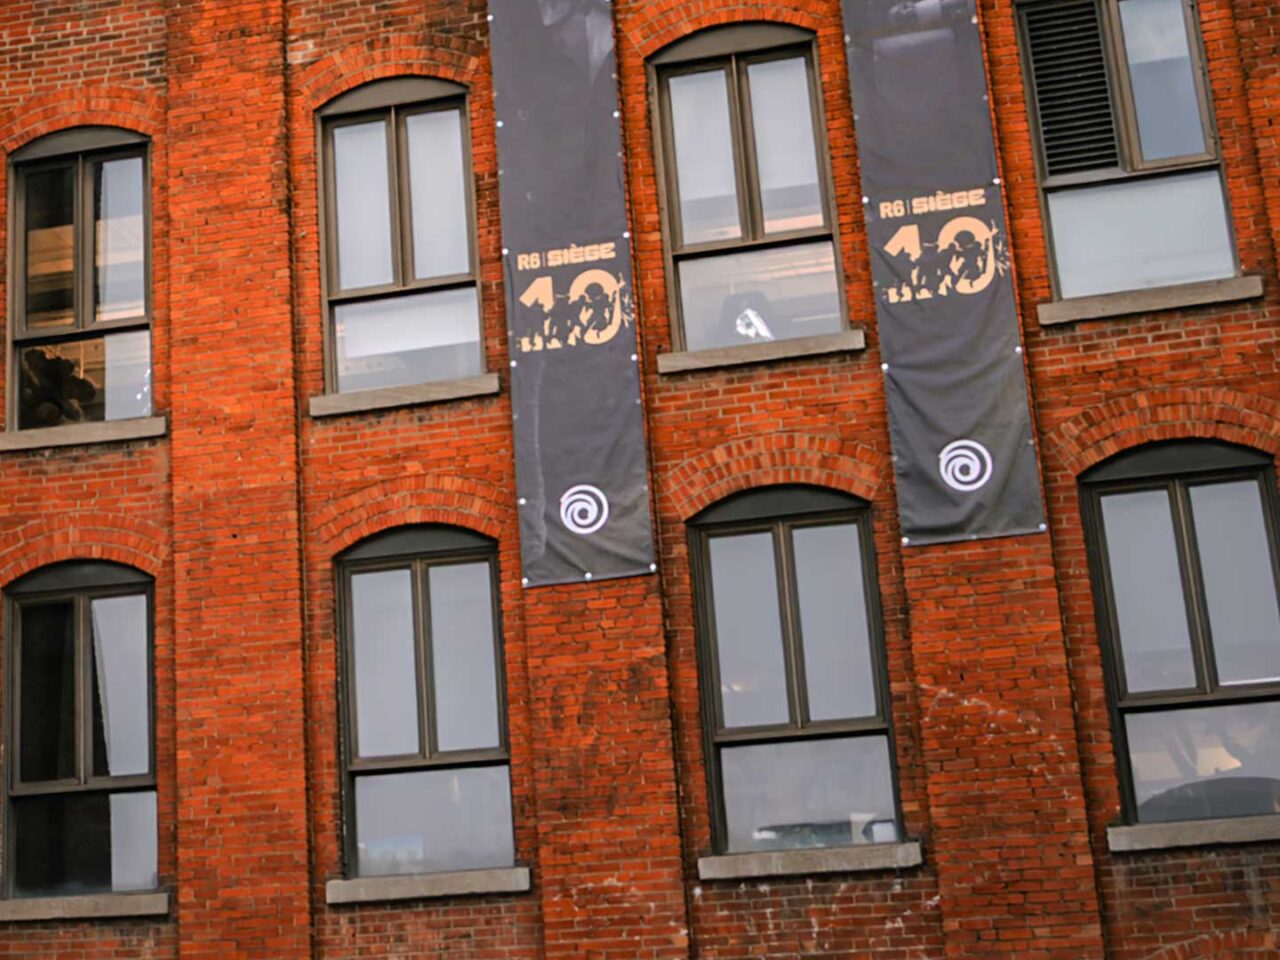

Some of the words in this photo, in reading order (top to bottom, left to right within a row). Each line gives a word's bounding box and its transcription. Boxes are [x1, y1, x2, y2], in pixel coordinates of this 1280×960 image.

[879, 199, 905, 219] R6
[911, 188, 987, 214] SIÈGE
[517, 252, 540, 271] R6
[547, 242, 616, 267] SIÈGE
[884, 216, 996, 304] 10
[519, 269, 621, 352] 10
